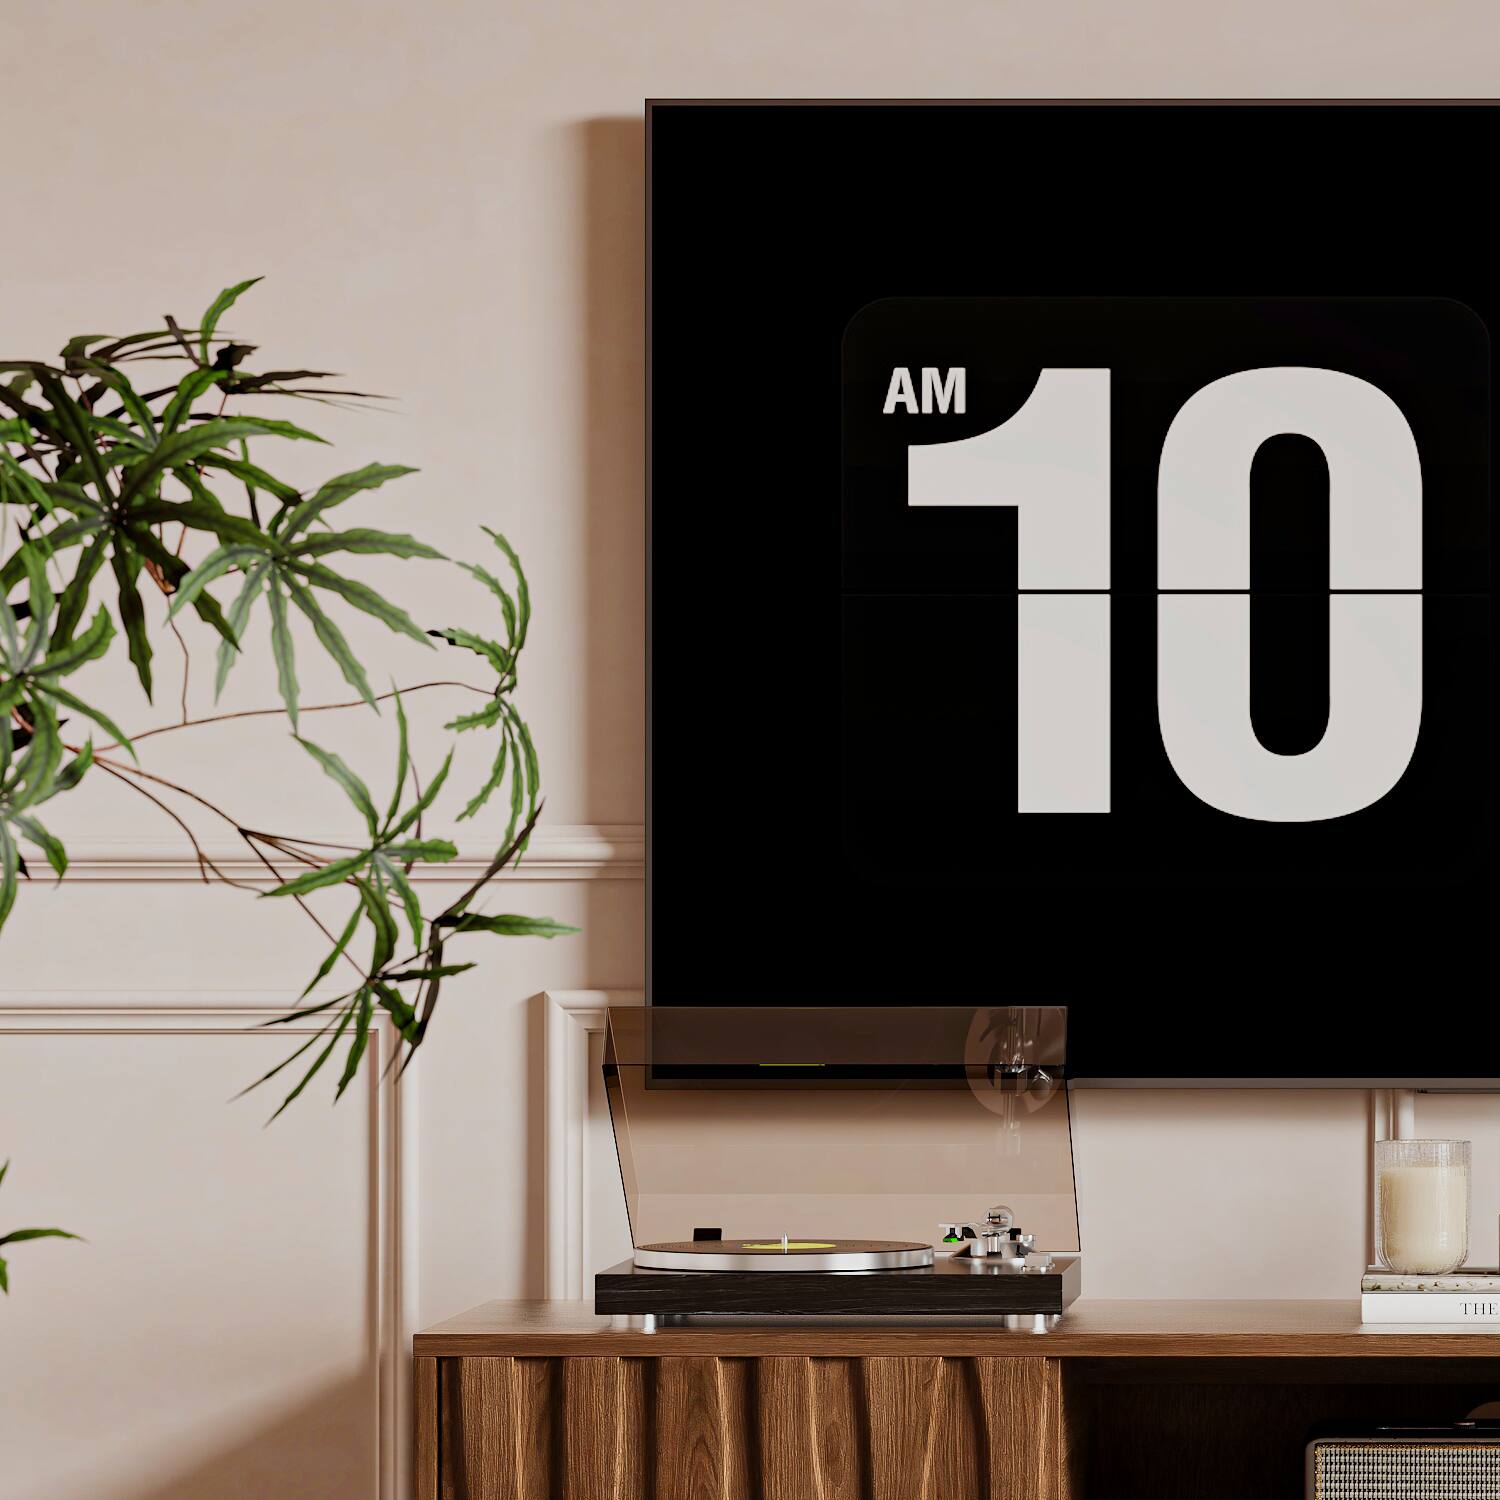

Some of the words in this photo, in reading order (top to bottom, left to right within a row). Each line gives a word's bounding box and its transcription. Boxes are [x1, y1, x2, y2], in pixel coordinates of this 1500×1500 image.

[882, 367, 966, 414] AM
[907, 366, 1423, 823] 10
[1460, 1301, 1499, 1316] THE
